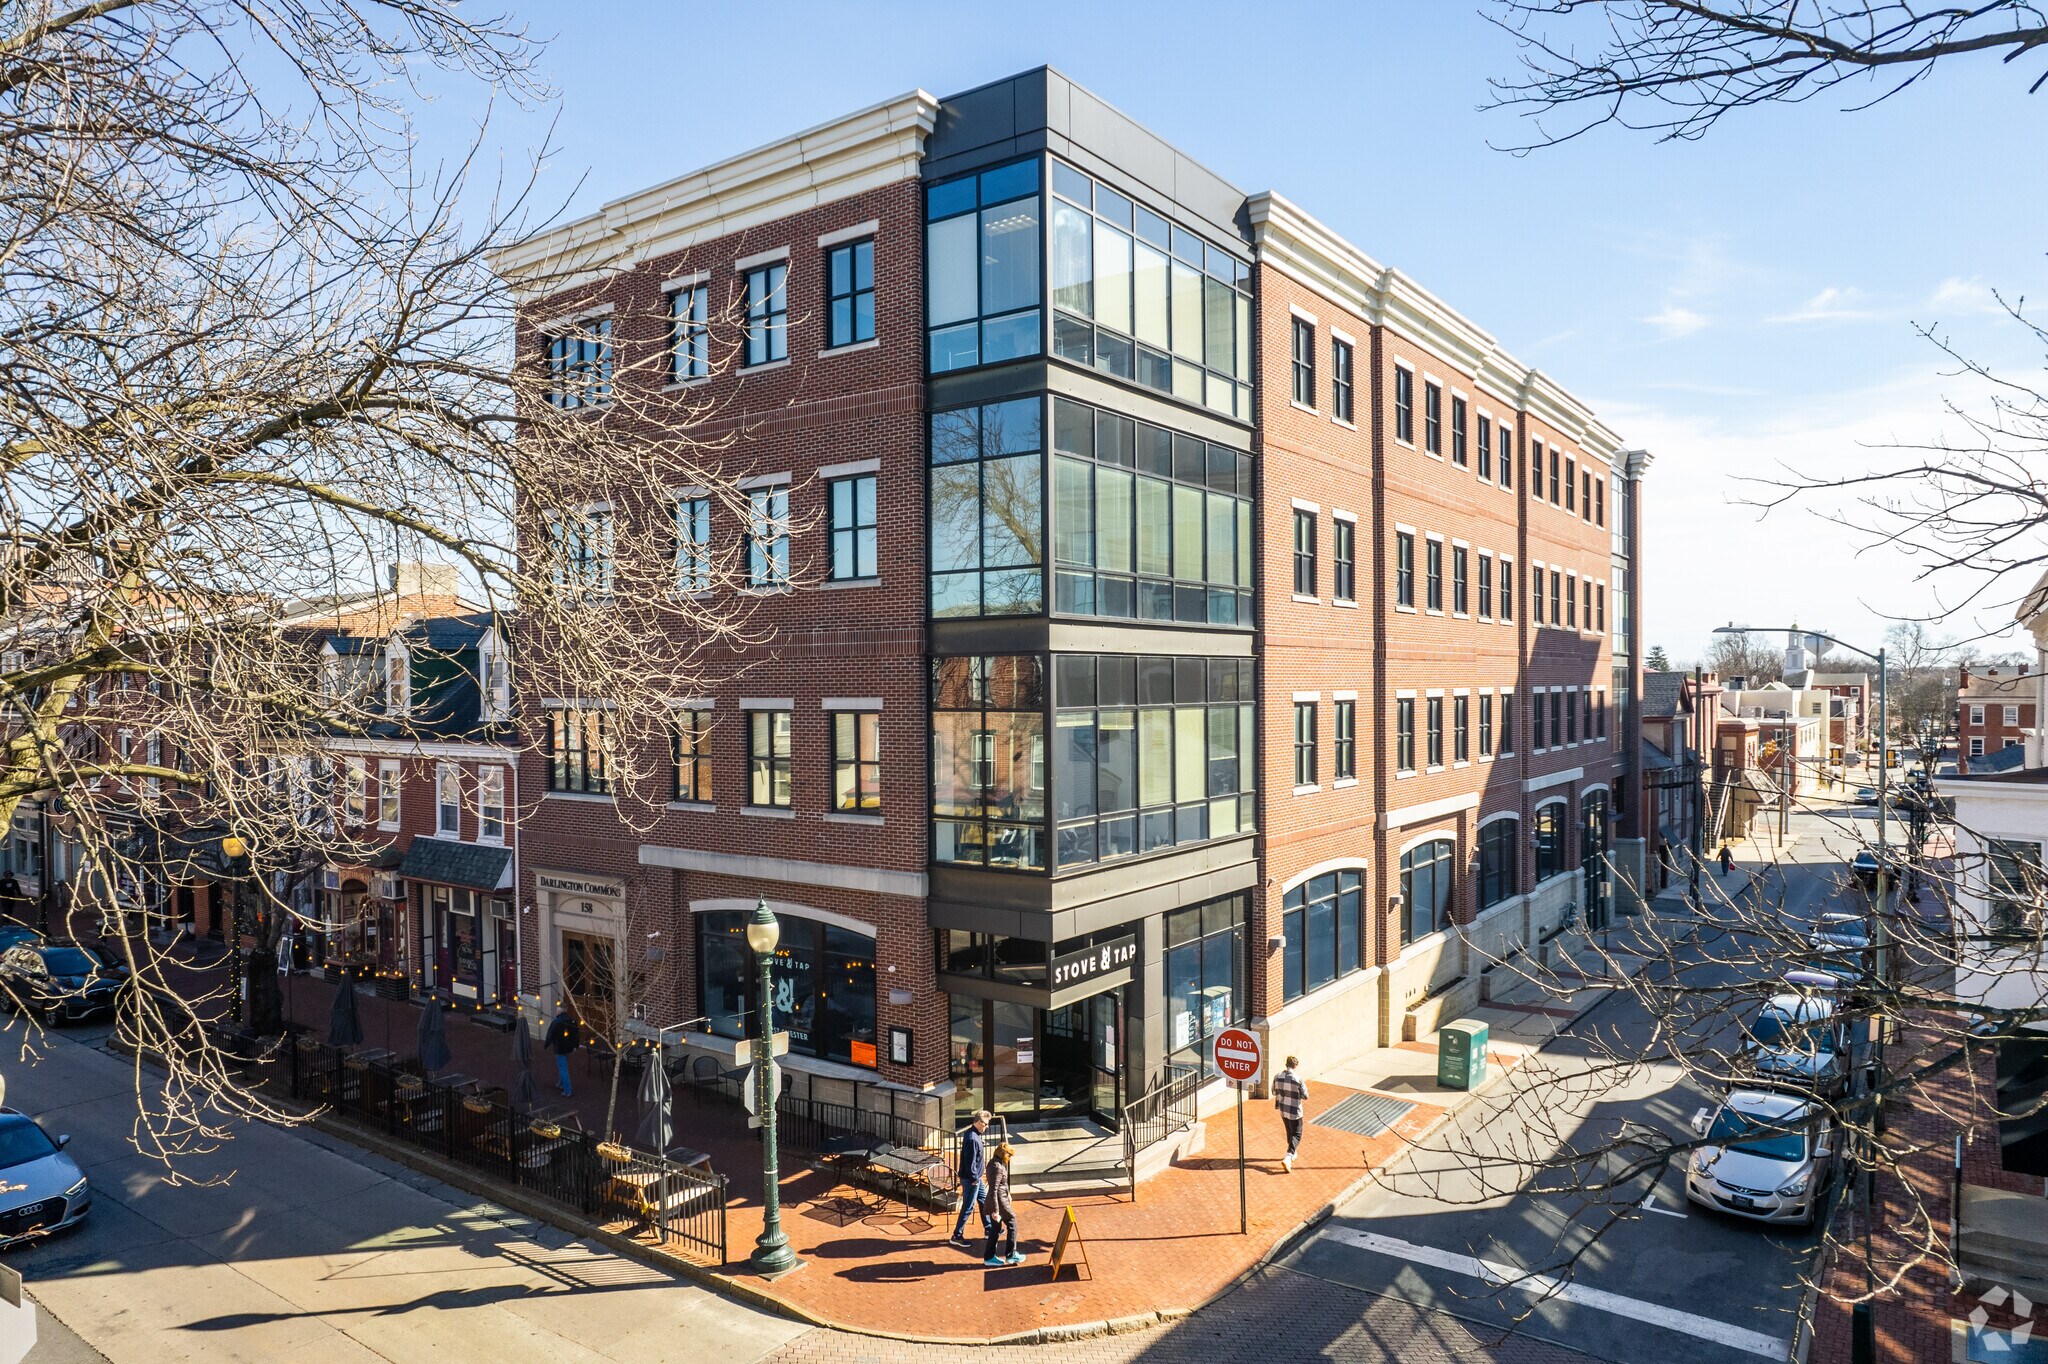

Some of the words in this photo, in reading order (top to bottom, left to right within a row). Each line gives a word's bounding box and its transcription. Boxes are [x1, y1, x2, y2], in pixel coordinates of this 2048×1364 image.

[540, 876, 583, 892] DARLINGTON
[584, 882, 621, 897] COMMONS
[581, 902, 593, 913] 158
[795, 961, 810, 970] TAP
[1055, 956, 1096, 984] STOVE
[1100, 945, 1111, 971] &
[1114, 944, 1136, 964] TAP
[1221, 1037, 1232, 1047] DO
[1236, 1040, 1252, 1050] NOT
[1224, 1060, 1250, 1072] ENTER
